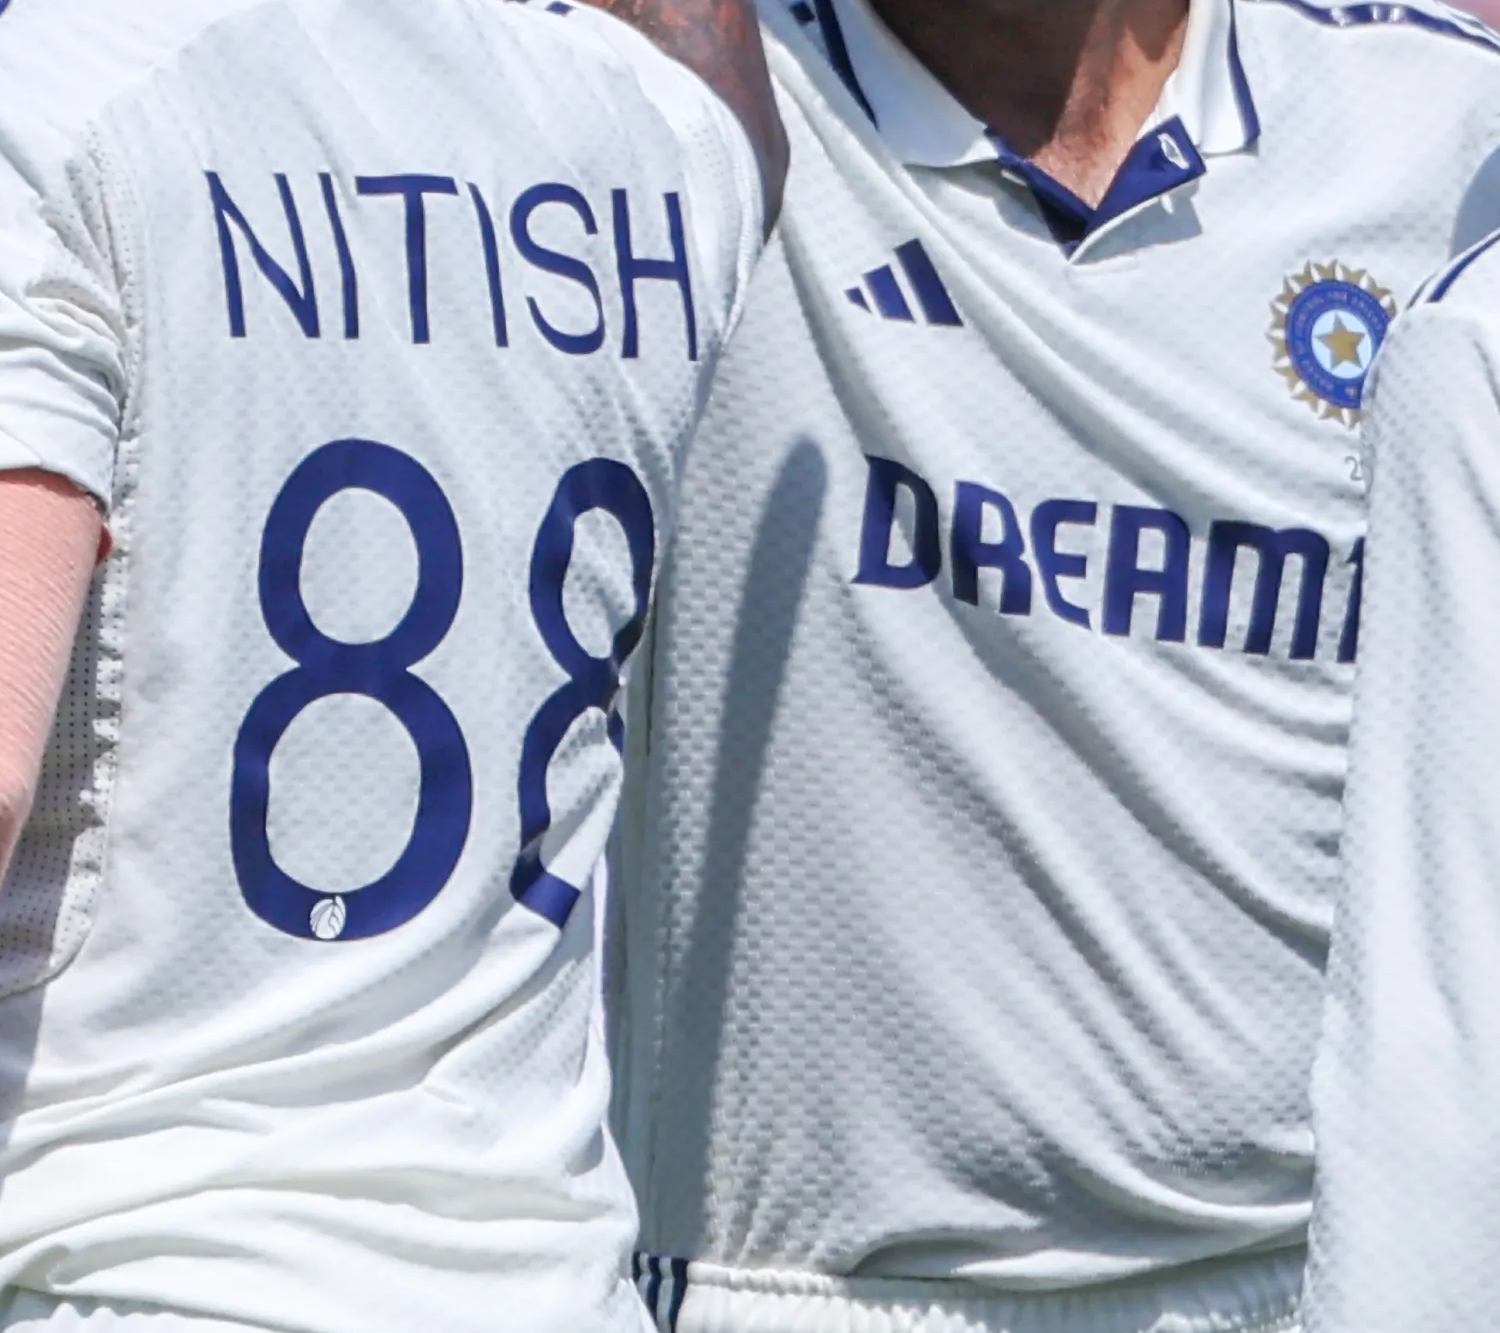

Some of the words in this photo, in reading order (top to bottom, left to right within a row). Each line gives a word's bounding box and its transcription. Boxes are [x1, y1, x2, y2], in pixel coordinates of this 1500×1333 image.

[204, 170, 699, 363] NITISH
[852, 453, 1366, 664] DREAM1
[228, 437, 656, 943] 88
